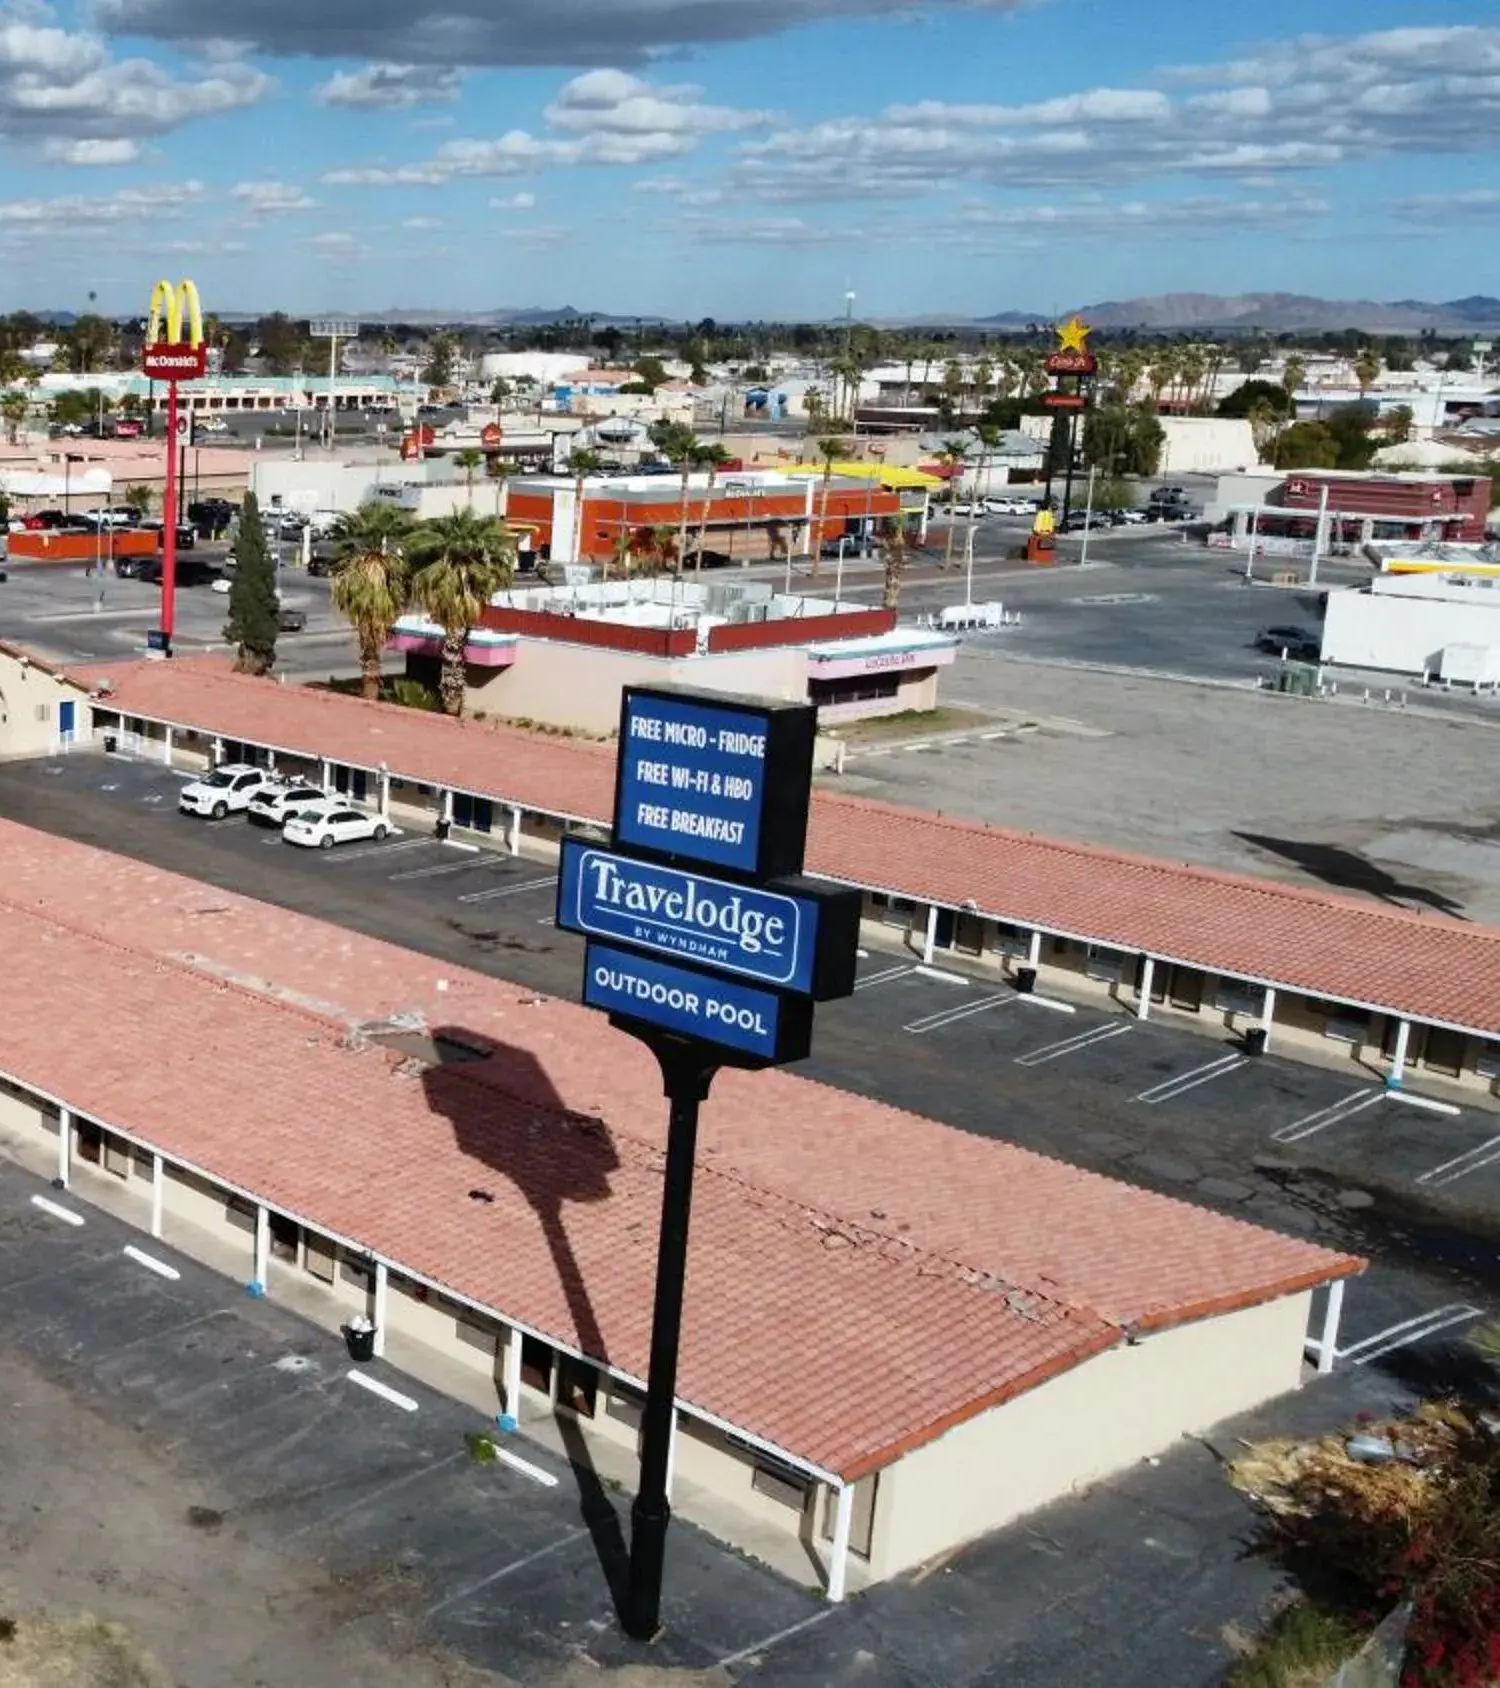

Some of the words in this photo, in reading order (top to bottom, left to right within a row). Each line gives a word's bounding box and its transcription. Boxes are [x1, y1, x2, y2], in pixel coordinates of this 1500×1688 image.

[145, 354, 199, 367] McDonald's
[631, 715, 662, 741] FREE
[664, 721, 707, 749] MICRO
[718, 729, 767, 759] FRIDGE
[637, 760, 669, 786] FREE
[671, 765, 709, 793] WI-FI
[711, 772, 721, 795] &
[723, 775, 753, 801] HBO
[637, 803, 670, 830] FREE
[671, 809, 745, 845] BREAKFAST
[589, 858, 785, 953] Travelodge
[634, 925, 651, 938] BY
[656, 929, 729, 960] WYNDHAM
[595, 967, 699, 1015] OUTDOOR
[705, 998, 768, 1035] POOL
